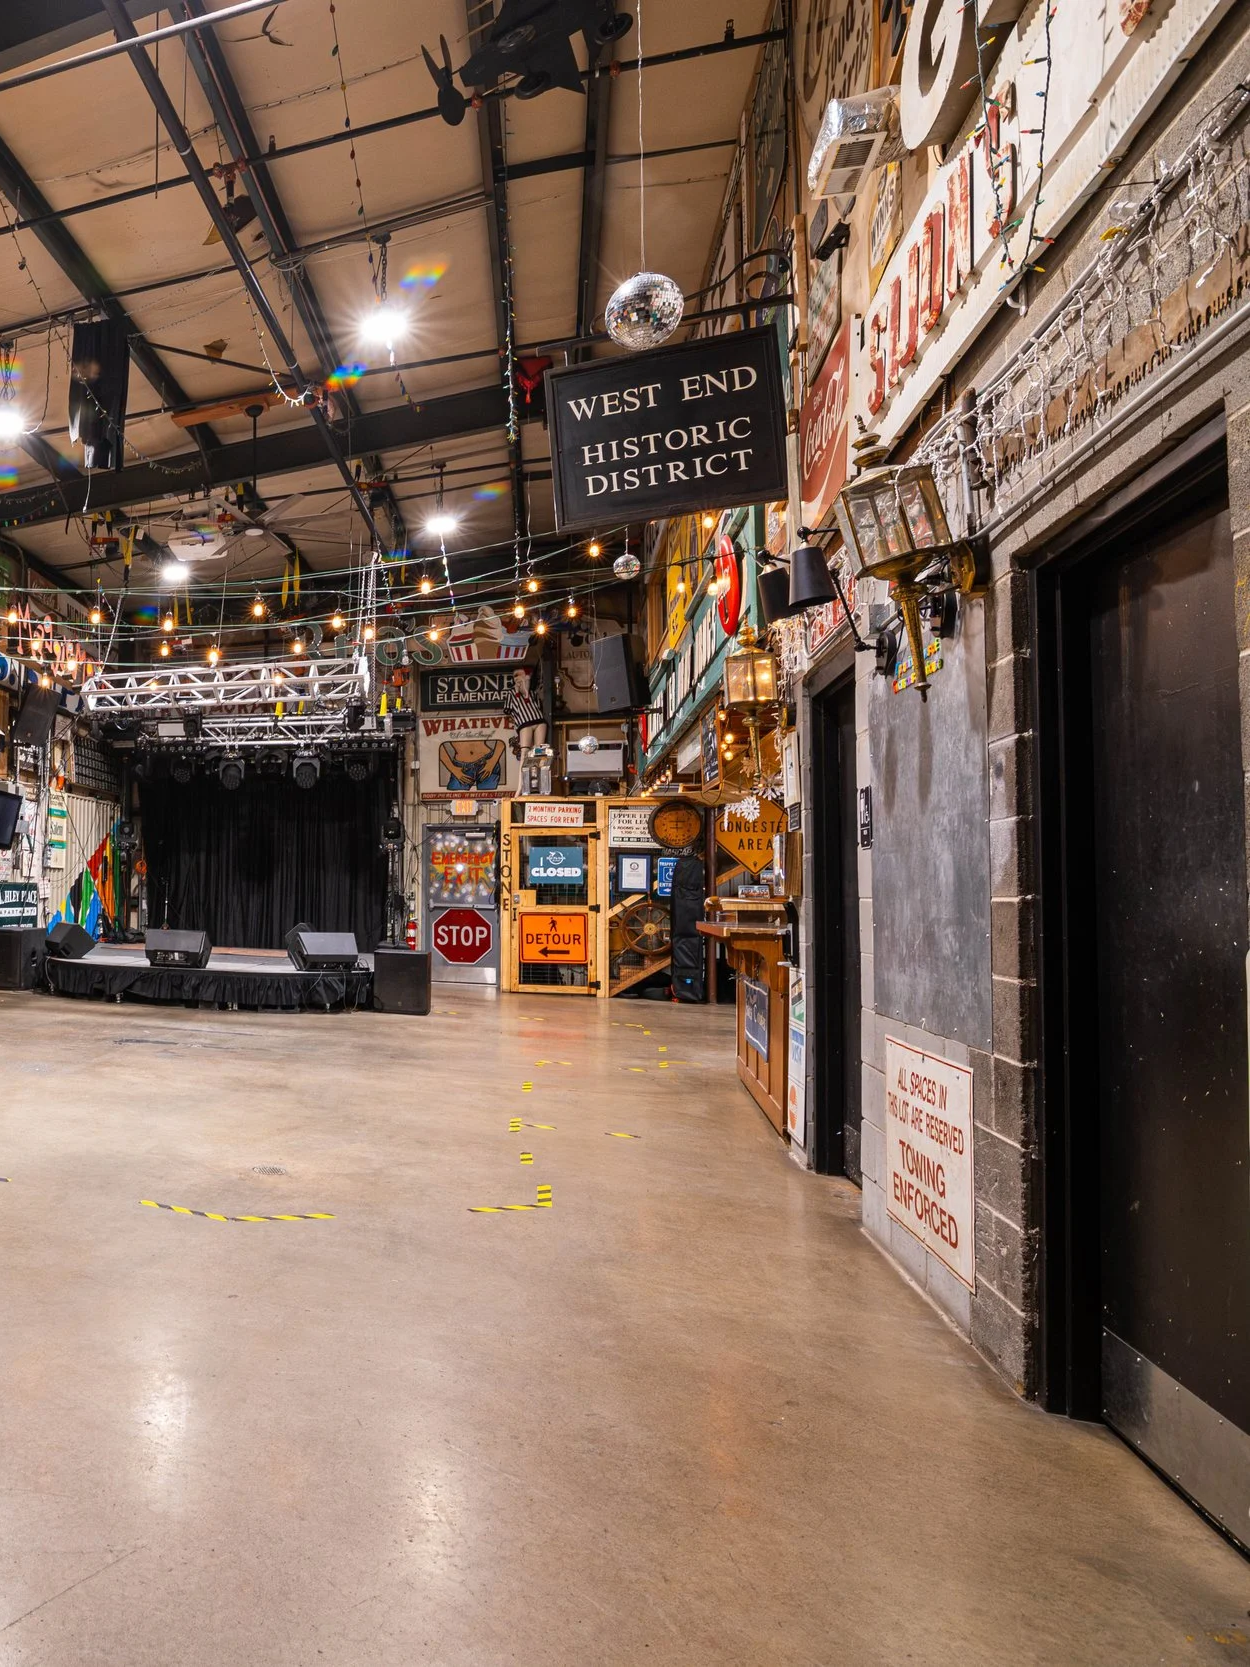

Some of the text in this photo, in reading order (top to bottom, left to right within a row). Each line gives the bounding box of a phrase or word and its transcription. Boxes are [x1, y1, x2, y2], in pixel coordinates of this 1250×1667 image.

[567, 366, 757, 421] WEST END
[581, 416, 752, 466] HISTORIC
[585, 448, 753, 496] DISTRICT
[455, 800, 473, 813] EXIT
[533, 805, 582, 814] MONTHLY PARKING
[527, 815, 548, 823] SPACES
[563, 816, 579, 824] RENT
[738, 838, 774, 850] AREA
[431, 850, 495, 866] EMERGENCY
[531, 867, 581, 877] CLOSED
[436, 925, 488, 947] STOP
[525, 933, 581, 945] DETOUR
[897, 1066, 947, 1111] ALL SPACES IN
[899, 1097, 909, 1125] LOT
[911, 1103, 923, 1133] ARE
[925, 1113, 964, 1156] RESERVED
[899, 1139, 946, 1199] TOWING
[893, 1171, 958, 1250] ENFORCED
